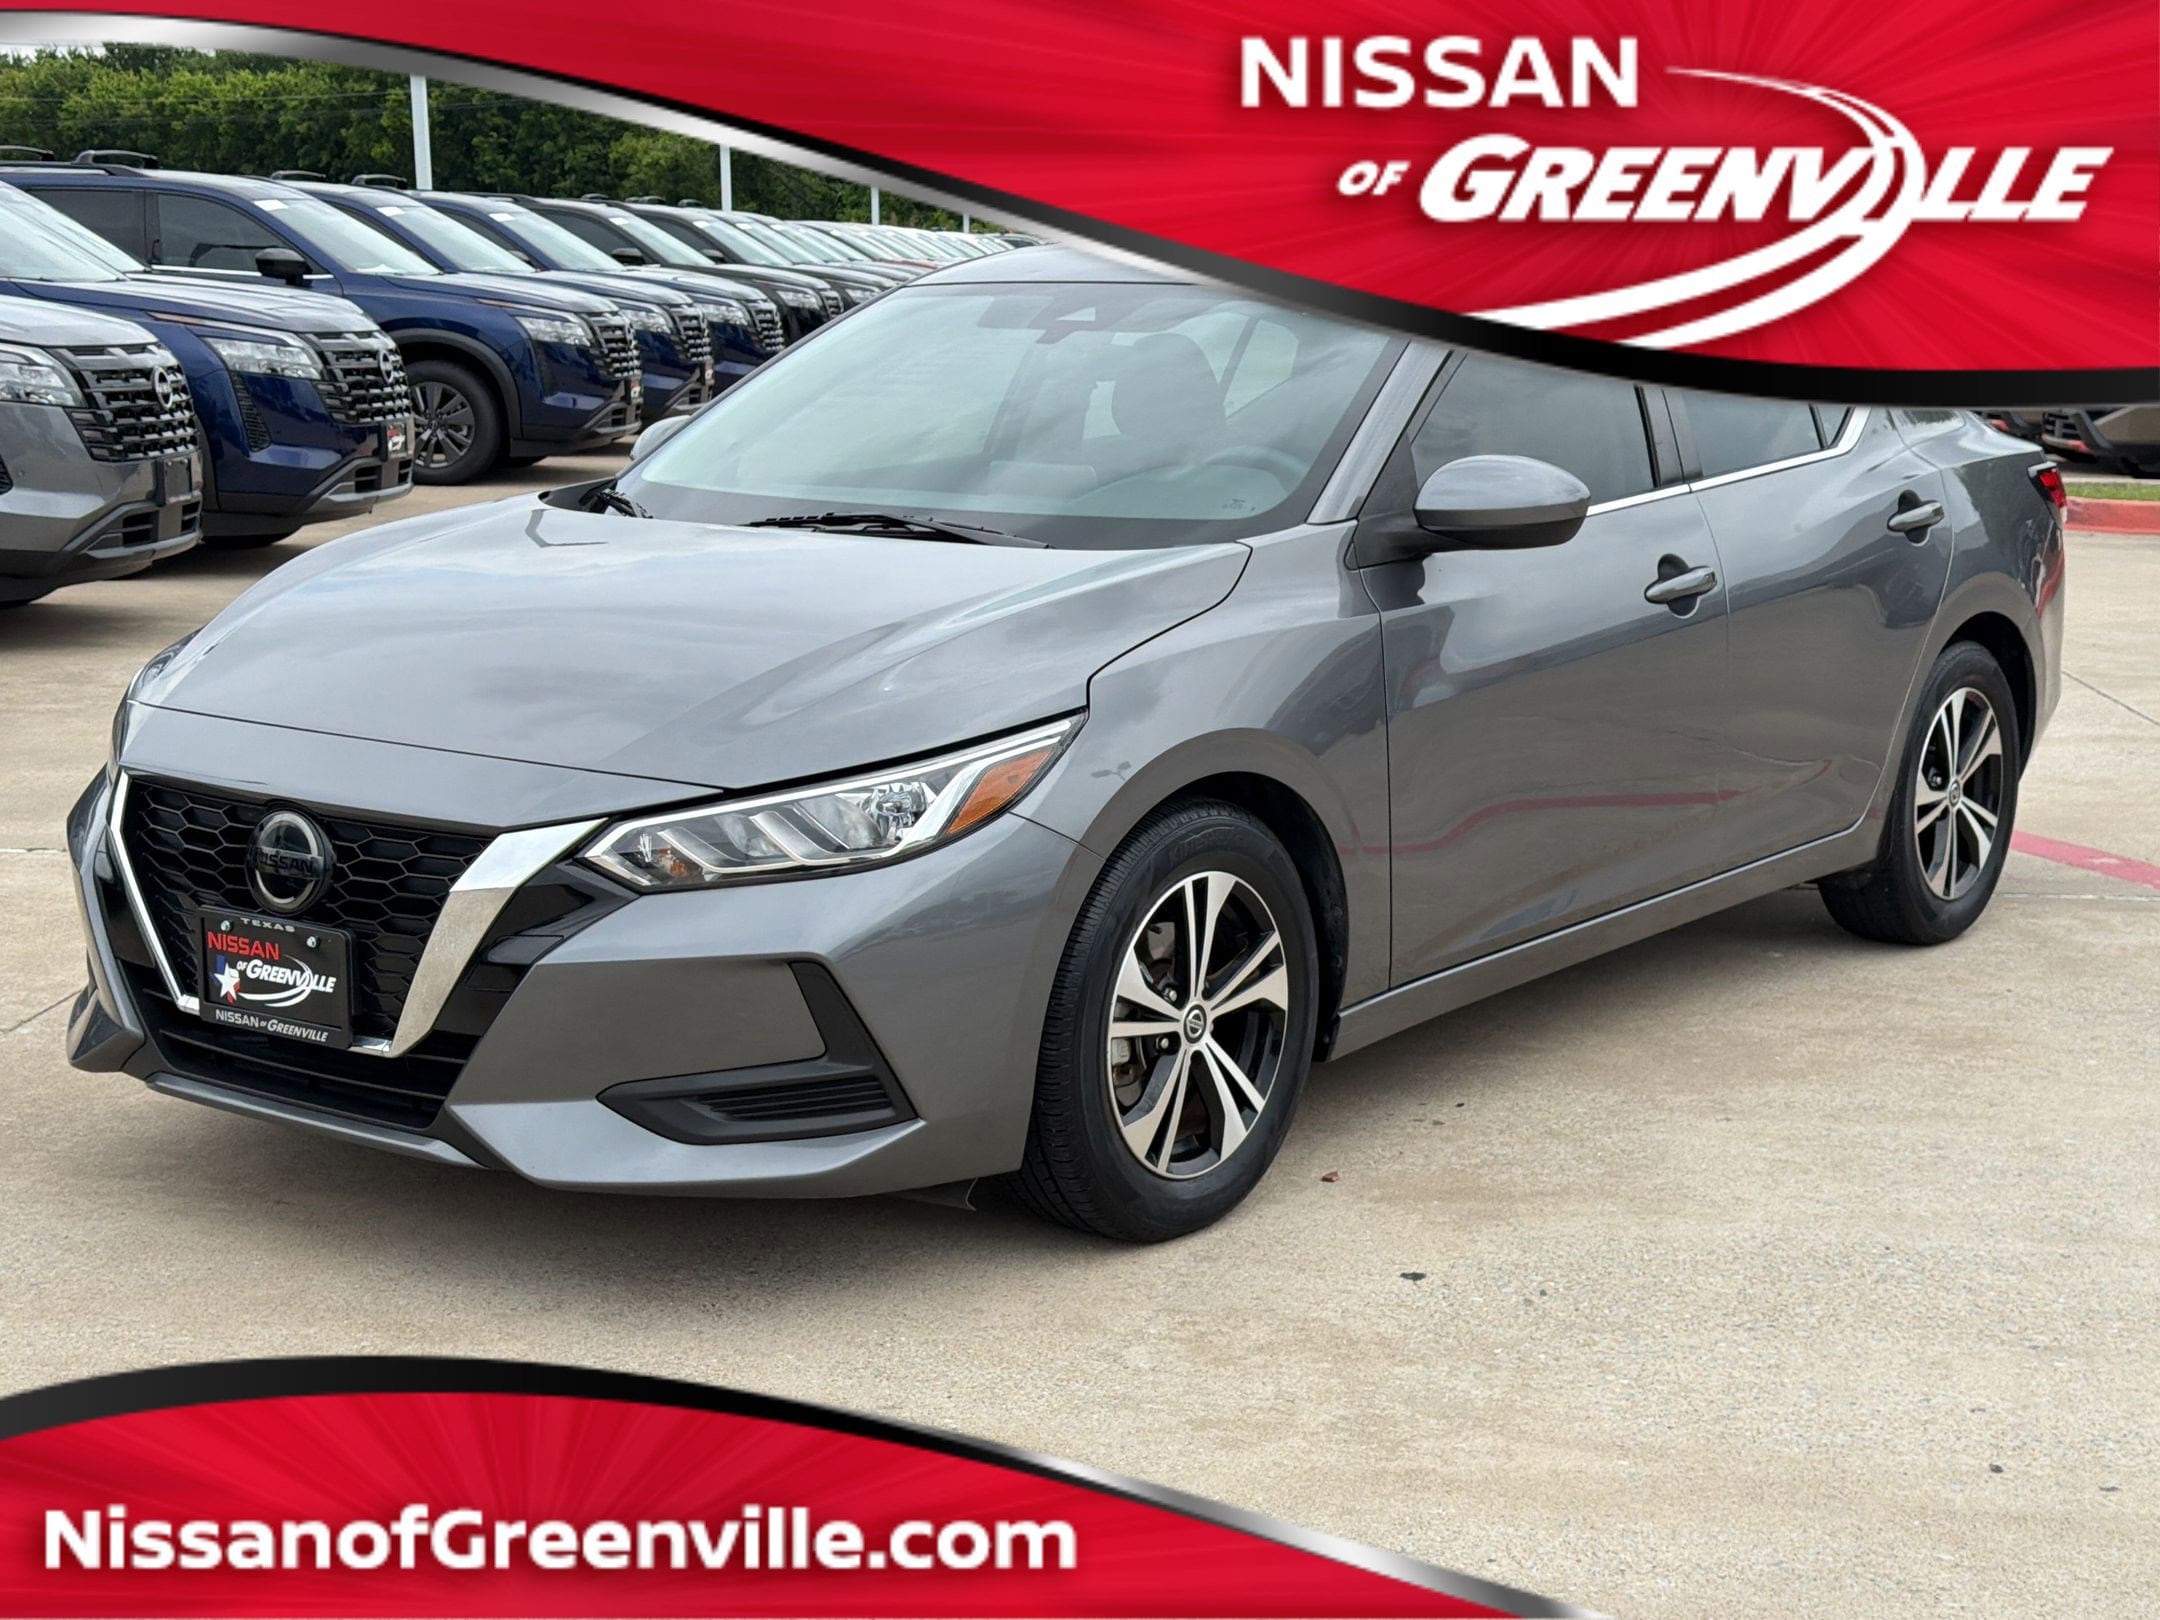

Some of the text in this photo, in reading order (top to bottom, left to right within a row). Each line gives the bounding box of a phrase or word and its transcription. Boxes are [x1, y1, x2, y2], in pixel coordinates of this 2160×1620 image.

[257, 851, 314, 874] NISSAN
[240, 917, 295, 933] TEXAS
[207, 931, 280, 961] NISSAN
[246, 959, 337, 993] GREENVILLE
[215, 1009, 259, 1028] NISSAN
[267, 1019, 329, 1042] GREENVILLE
